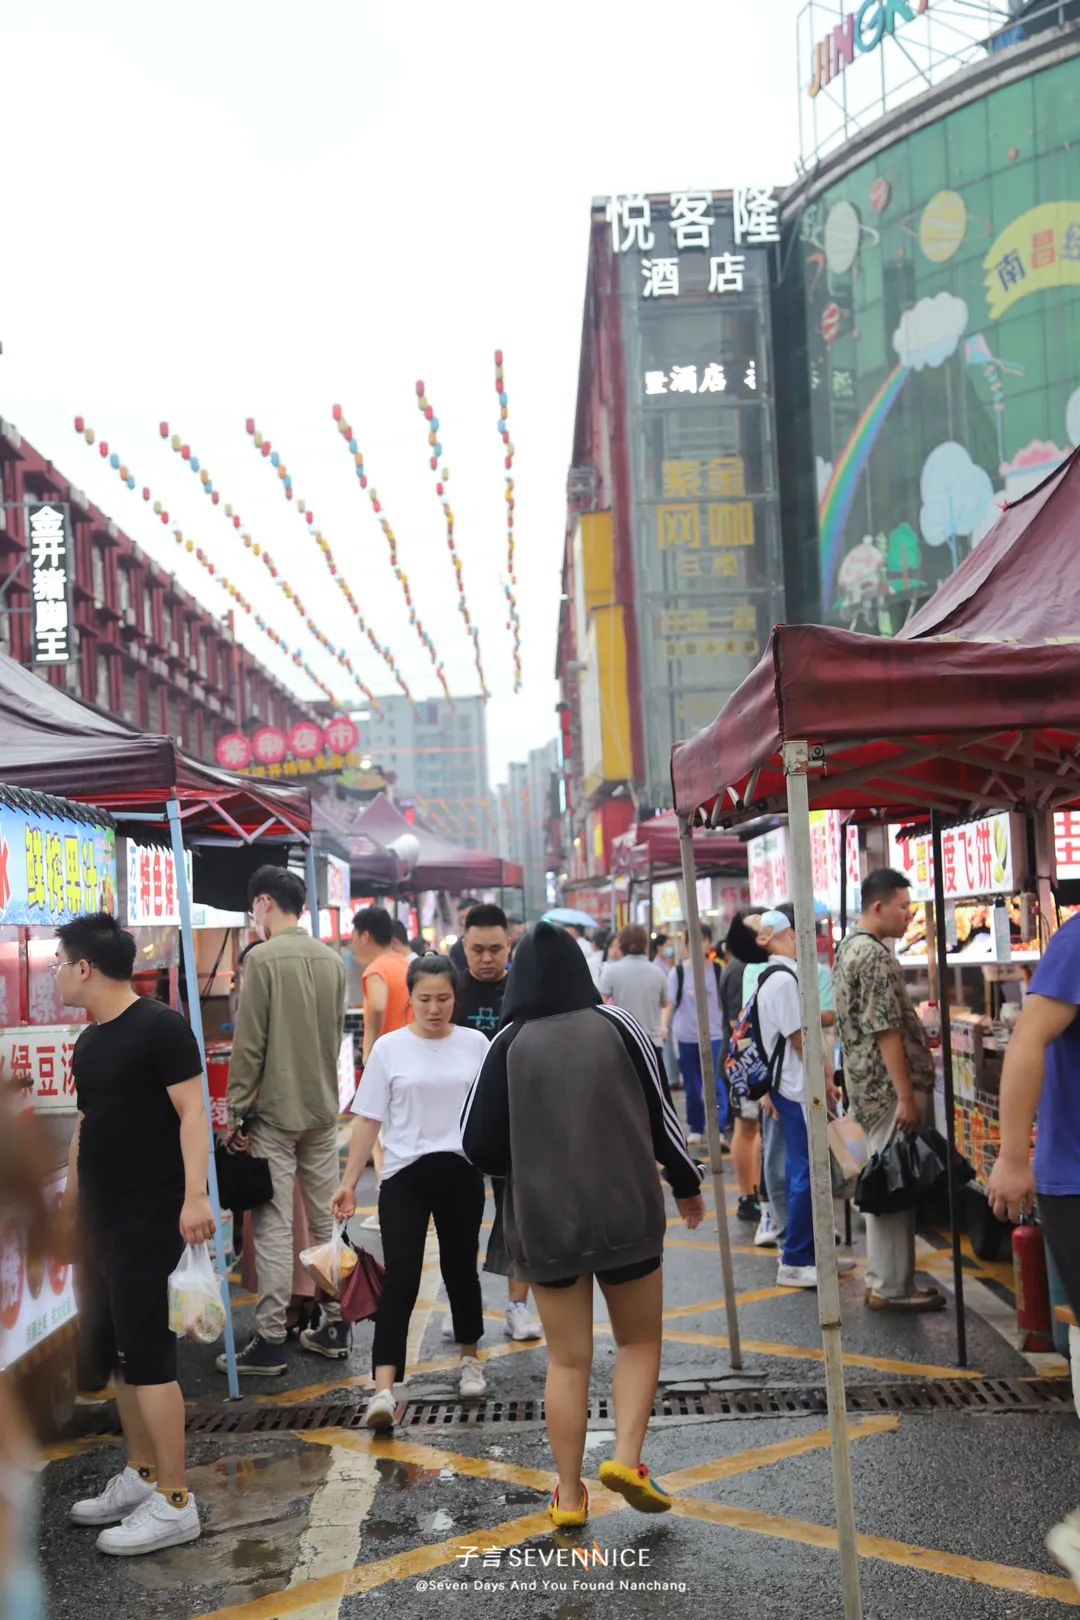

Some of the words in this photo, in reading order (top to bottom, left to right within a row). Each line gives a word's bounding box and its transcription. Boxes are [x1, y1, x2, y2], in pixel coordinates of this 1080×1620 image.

[808, 0, 928, 97] JINGK
[606, 186, 781, 253] 悦客隆
[641, 252, 745, 298] 酒店
